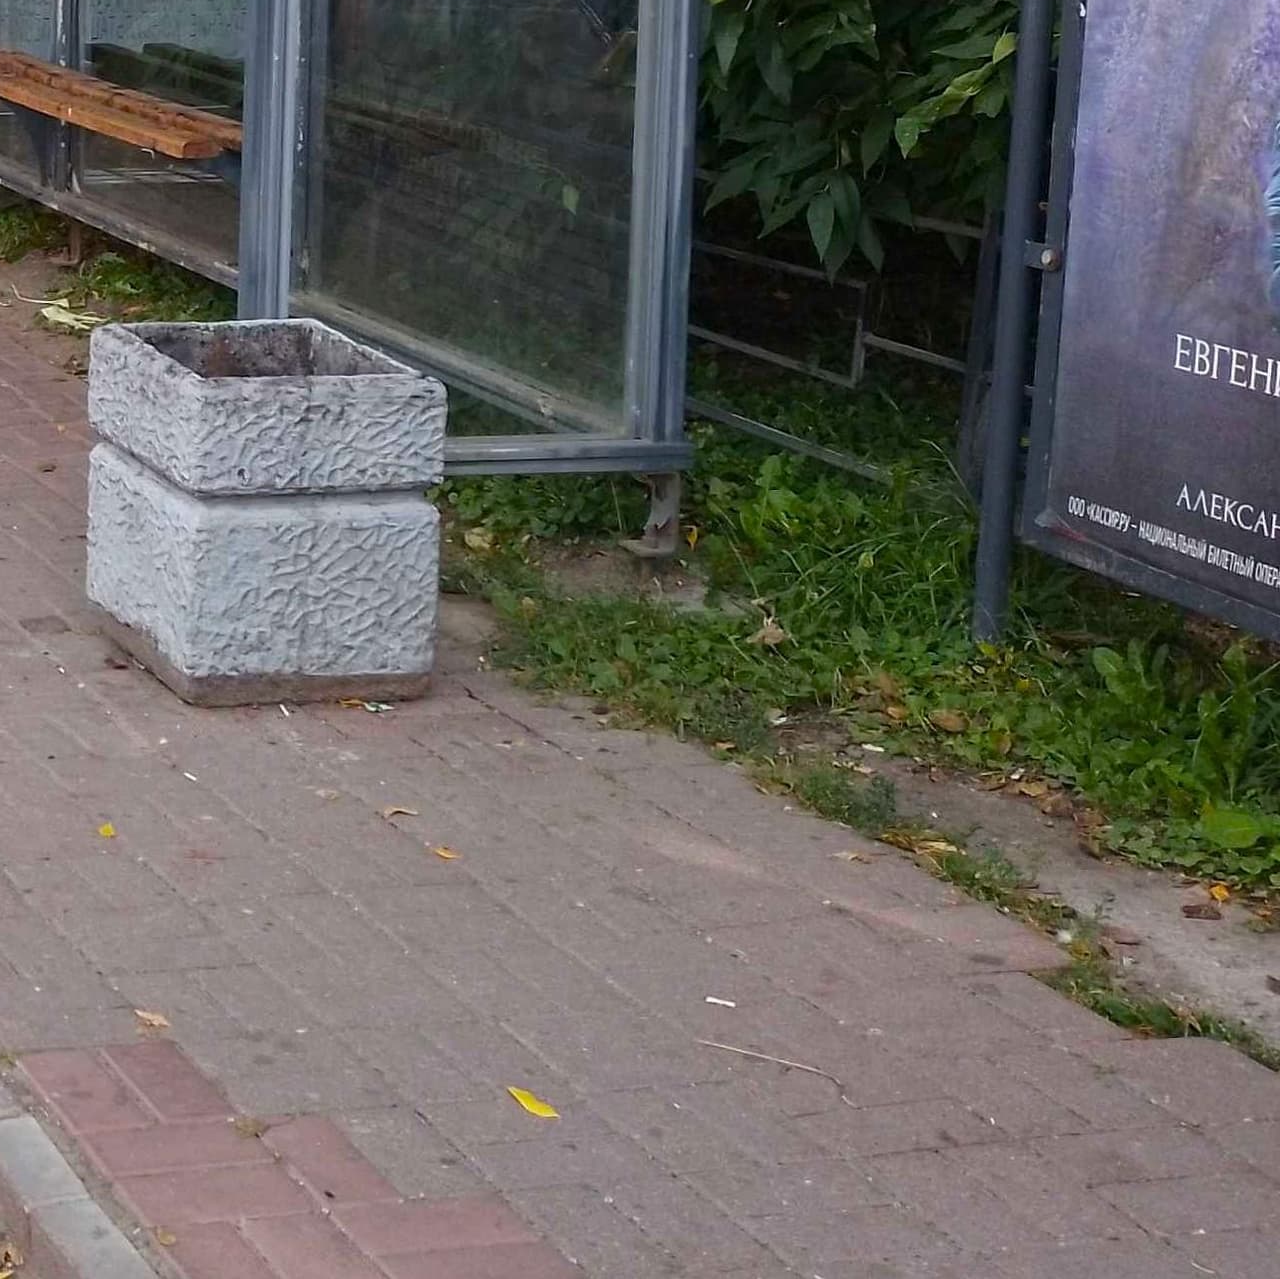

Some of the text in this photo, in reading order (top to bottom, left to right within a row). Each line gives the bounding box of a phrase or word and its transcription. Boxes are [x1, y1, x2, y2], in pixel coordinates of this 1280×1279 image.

[1067, 495, 1086, 518] ООО
[1138, 519, 1207, 562] НАЦИОНАЛЬНЫЙ
[1207, 544, 1256, 580] БИЛЕТНЫЙ
